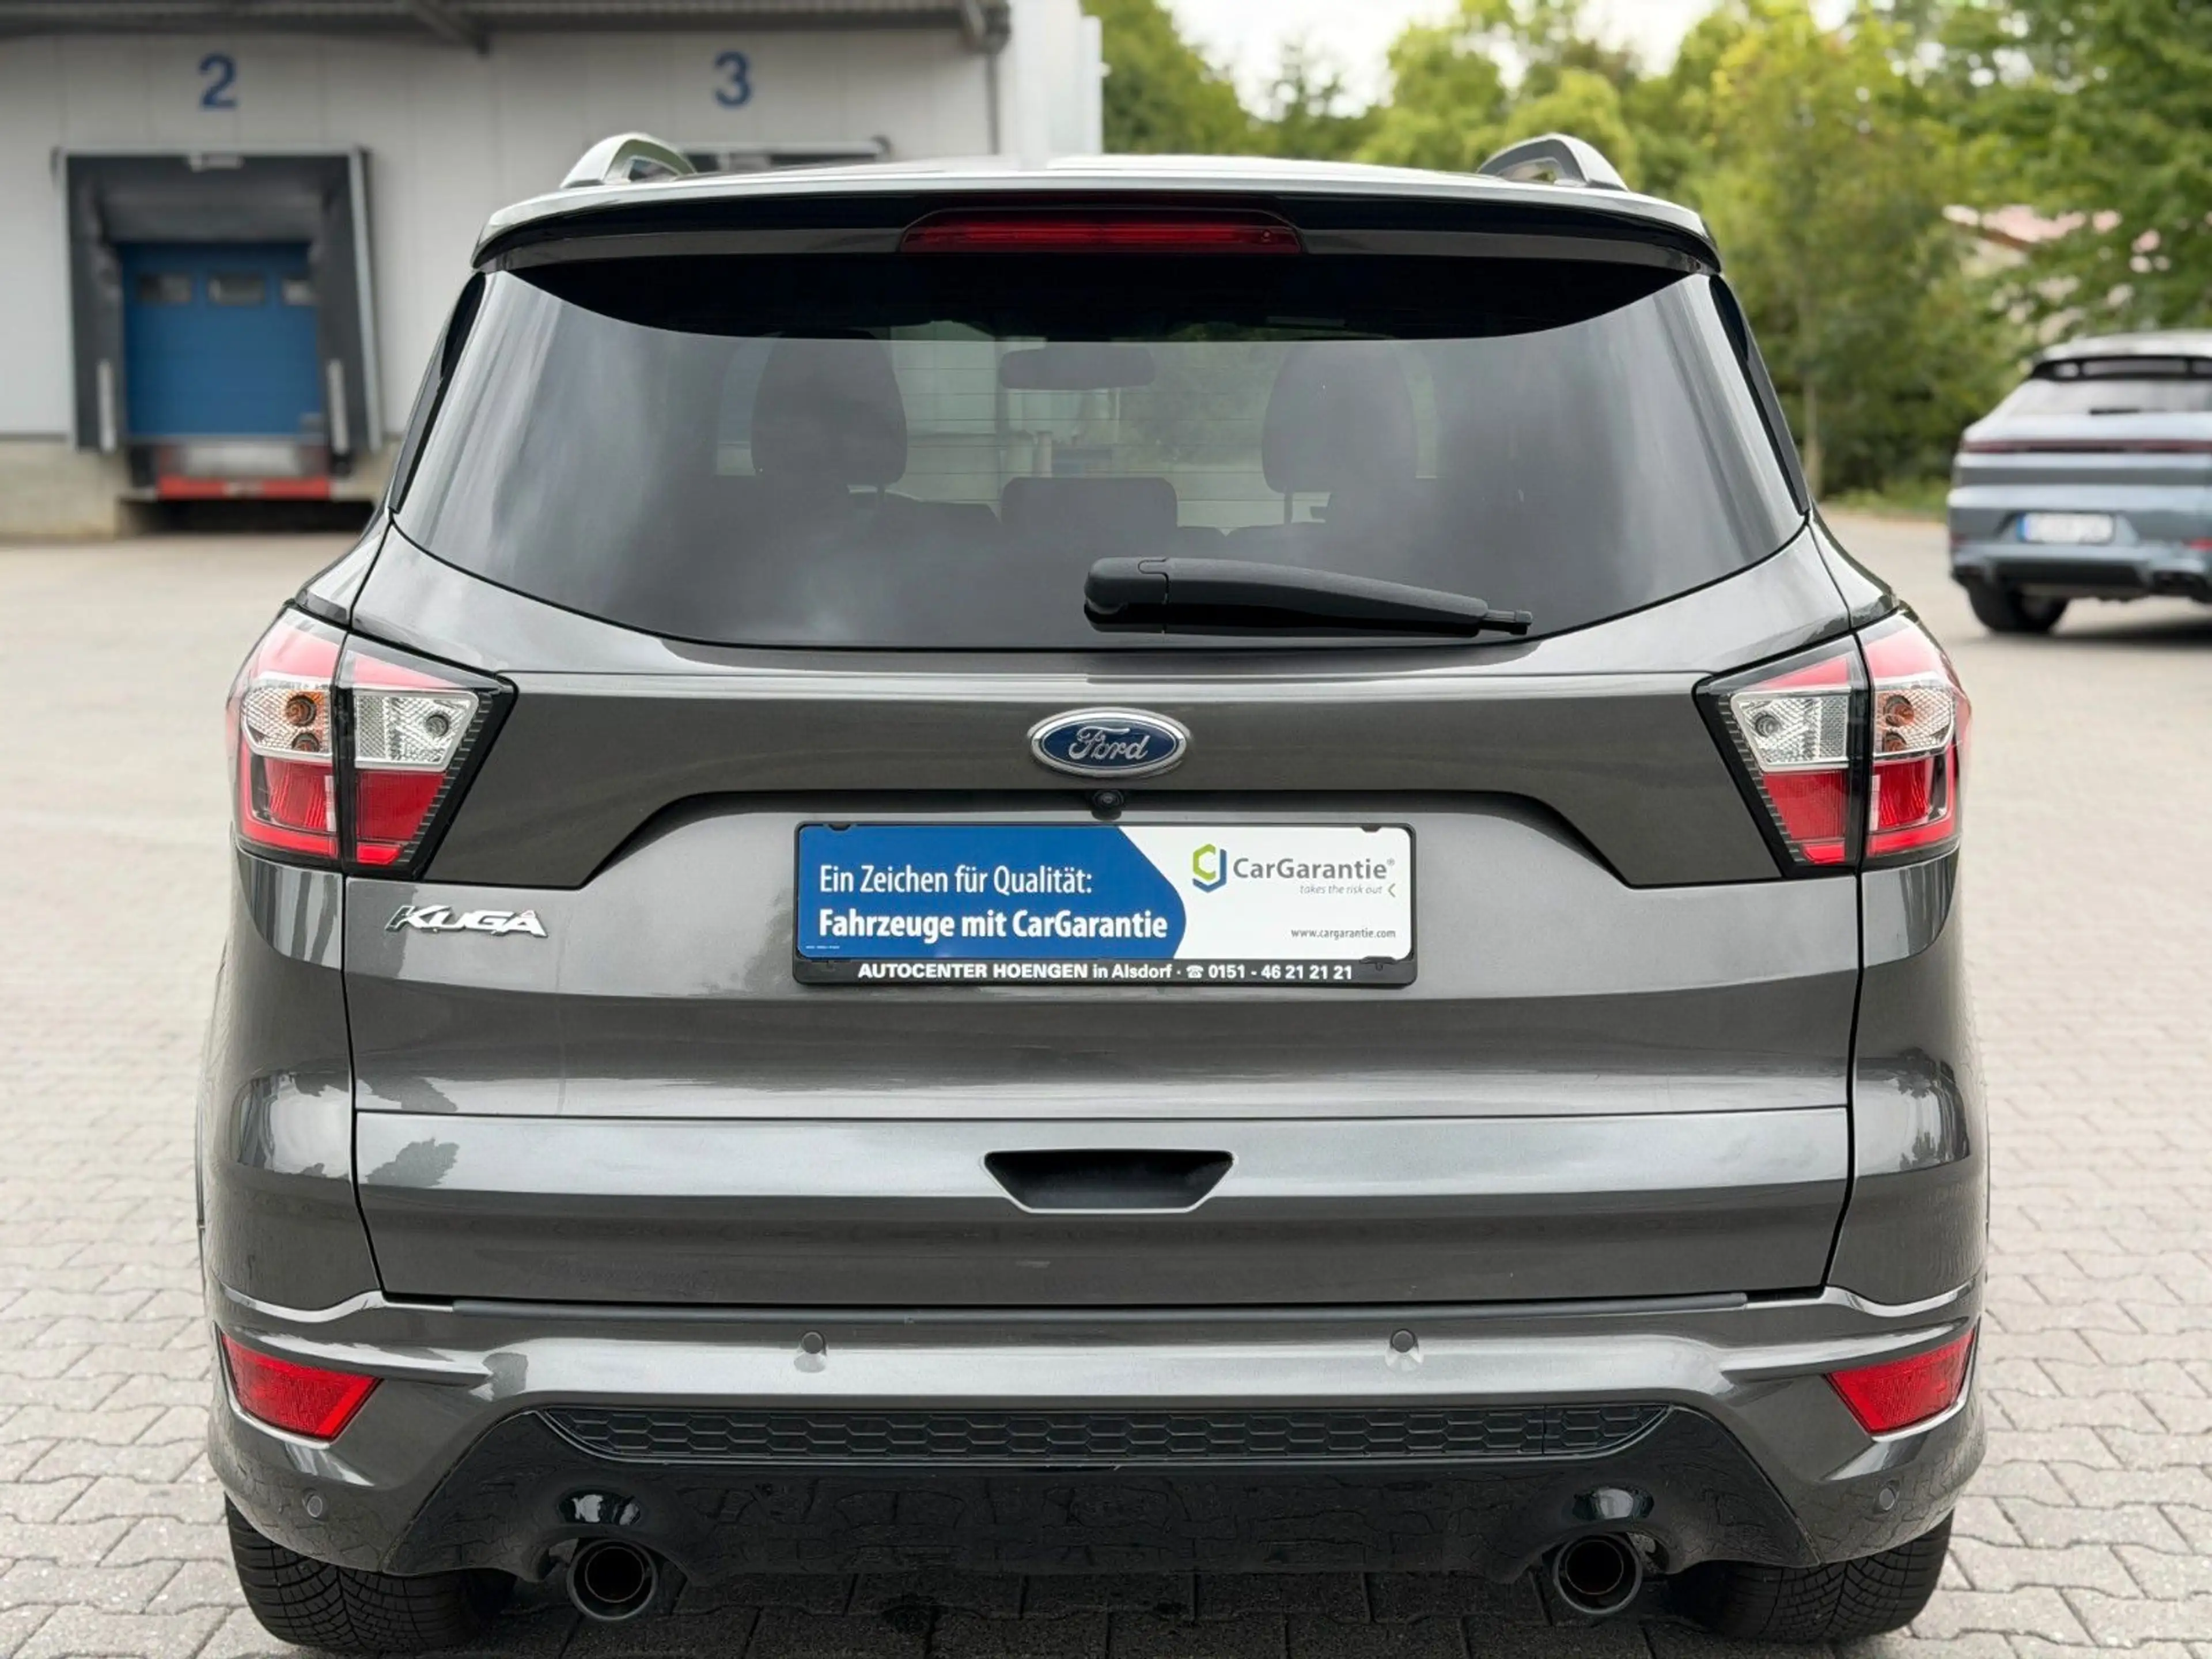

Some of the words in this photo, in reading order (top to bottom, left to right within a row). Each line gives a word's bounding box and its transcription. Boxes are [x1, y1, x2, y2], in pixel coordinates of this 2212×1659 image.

[198, 52, 237, 111] 2
[714, 50, 751, 109] 3
[1069, 726, 1151, 760] Ford
[820, 865, 854, 893] Ein
[860, 865, 948, 893] Zeichen
[955, 865, 987, 893] für
[994, 865, 1092, 896] Qualität:
[1300, 884, 1326, 894] takes
[1328, 884, 1344, 894] the
[1346, 884, 1364, 894] risk
[1365, 885, 1382, 894] out
[385, 905, 548, 938] KUGA
[819, 908, 955, 944] Fahrzeuge
[961, 909, 1007, 937] mit
[1012, 909, 1168, 938] CarGarantie
[1290, 928, 1396, 941] www.cargarantie.com
[858, 963, 987, 979] AUTOCENTER
[993, 963, 1088, 978] HOENGEN
[1093, 964, 1108, 978] in
[1111, 964, 1173, 979] Alsdorf
[1208, 964, 1245, 979] 0151
[1260, 964, 1282, 979] 46
[1285, 964, 1304, 979] 21
[1309, 964, 1327, 979] 21
[1332, 964, 1353, 979] 21
